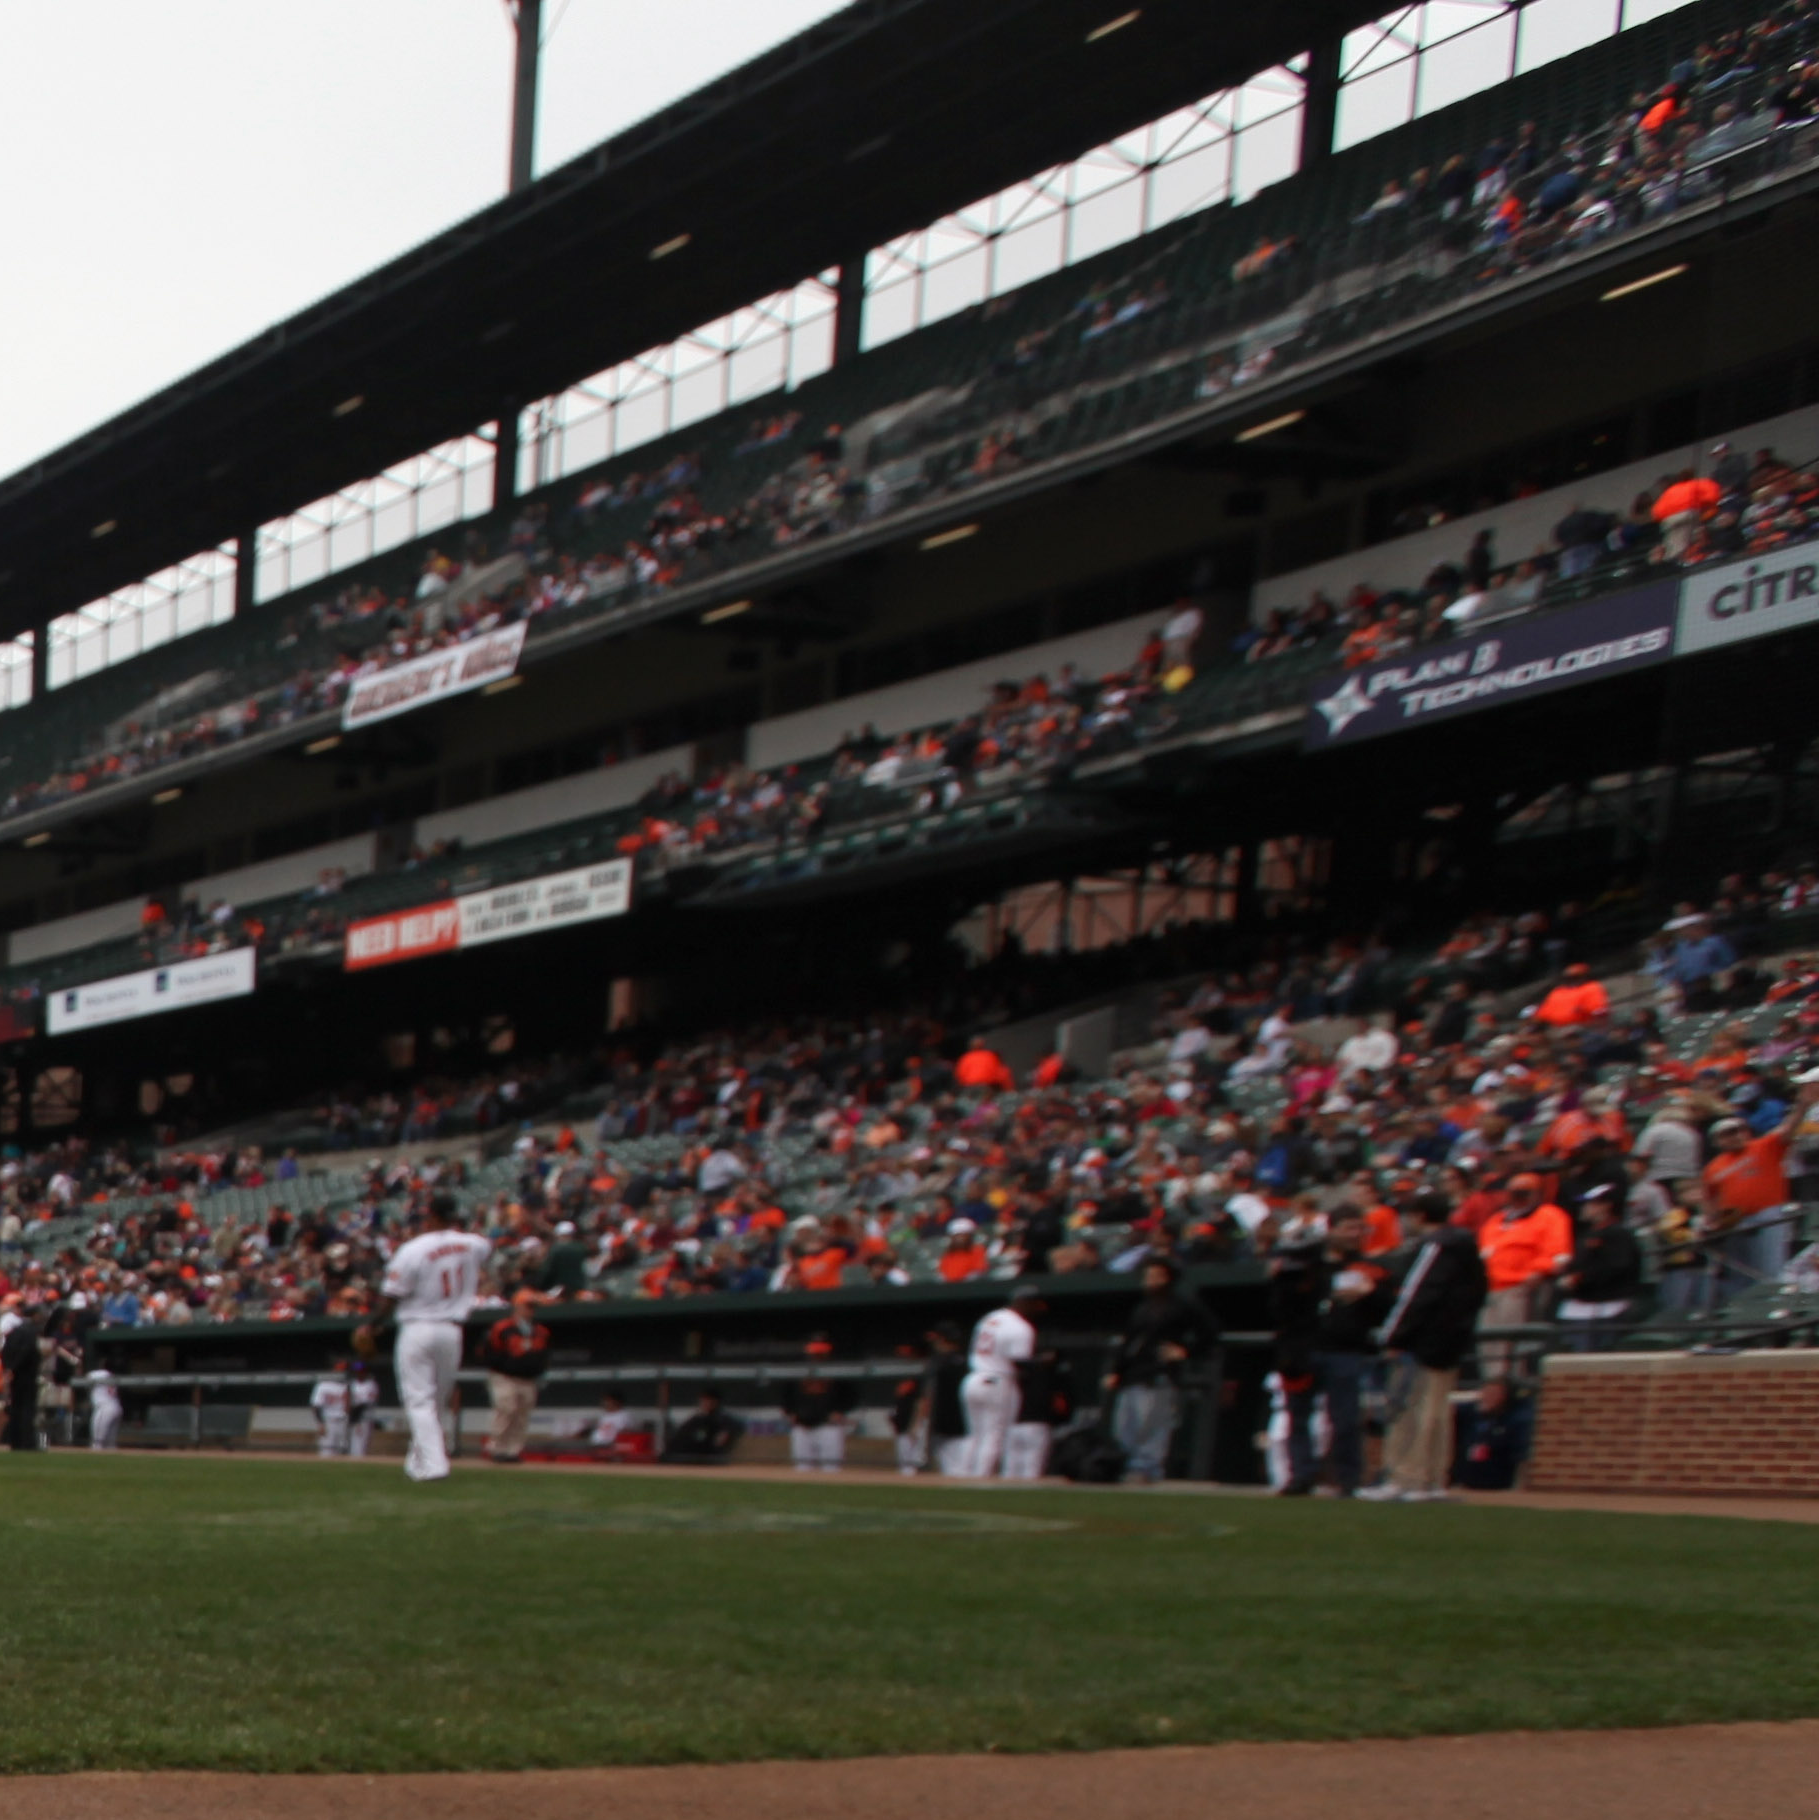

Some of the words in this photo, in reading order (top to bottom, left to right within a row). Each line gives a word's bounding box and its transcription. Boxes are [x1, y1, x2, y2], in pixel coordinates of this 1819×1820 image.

[1367, 653, 1463, 697] PLAN
[1470, 639, 1501, 676] B
[1400, 626, 1670, 718] TECHNOLOGIES
[349, 921, 395, 961] NEED
